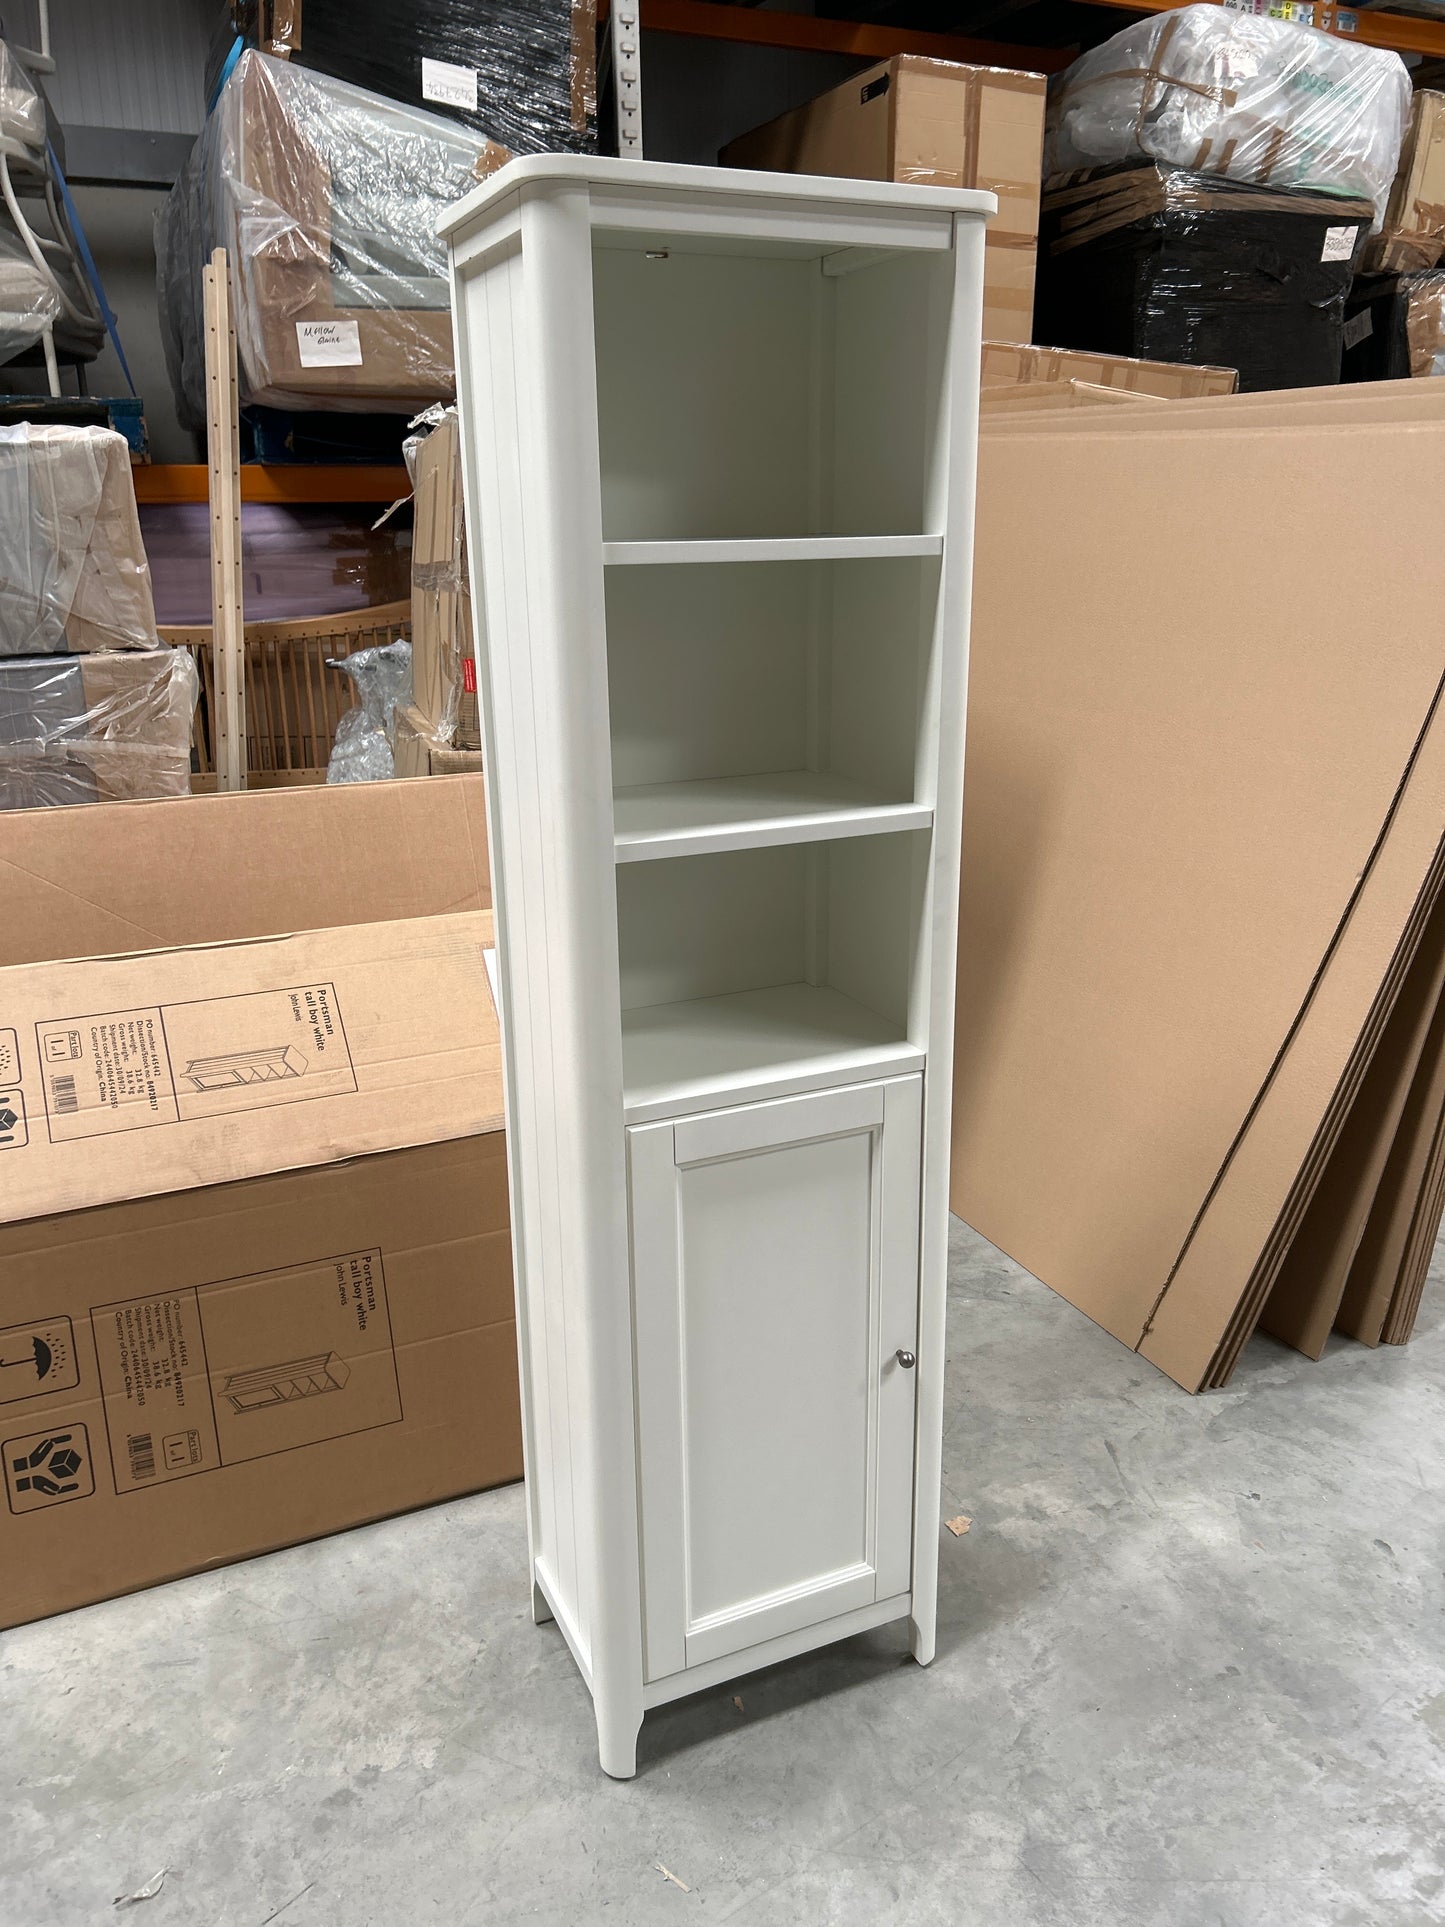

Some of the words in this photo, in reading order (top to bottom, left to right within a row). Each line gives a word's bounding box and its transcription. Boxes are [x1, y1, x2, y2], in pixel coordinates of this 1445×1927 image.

[287, 993, 299, 1006] John
[304, 991, 317, 1007] tall
[292, 1006, 302, 1022] Lewis
[309, 1009, 319, 1024] boy
[317, 989, 334, 1035] Portsman
[99, 1025, 108, 1042] Batch
[109, 1024, 118, 1052] Shipment
[118, 1023, 126, 1041] Gross
[313, 1027, 325, 1051] white
[90, 1027, 99, 1051] Country
[99, 1081, 107, 1102] China
[136, 1020, 150, 1069] Dissection/Stock
[146, 1080, 158, 1111] 84920217
[151, 1054, 161, 1077] 645442
[125, 1070, 134, 1084] 38.6
[135, 1069, 143, 1083] 32.8
[128, 1086, 136, 1095] kg
[137, 1085, 145, 1094] kg
[333, 1262, 345, 1282] John
[350, 1260, 362, 1278] tall
[352, 1280, 363, 1299] boy
[362, 1256, 376, 1311] Portsman
[338, 1282, 349, 1306] Lewis
[125, 1309, 134, 1329] Batch
[134, 1307, 144, 1339] Shipment
[144, 1305, 152, 1326] Gross
[356, 1302, 368, 1331] white
[115, 1311, 124, 1341] Country
[124, 1376, 133, 1399] China
[163, 1301, 177, 1359] Dissection/Stock
[173, 1372, 185, 1406] 84920217
[178, 1341, 188, 1366] 645442
[152, 1361, 161, 1377] 38.6
[161, 1358, 171, 1374] 32.8
[155, 1379, 163, 1390] kg
[164, 1377, 172, 1387] kg
